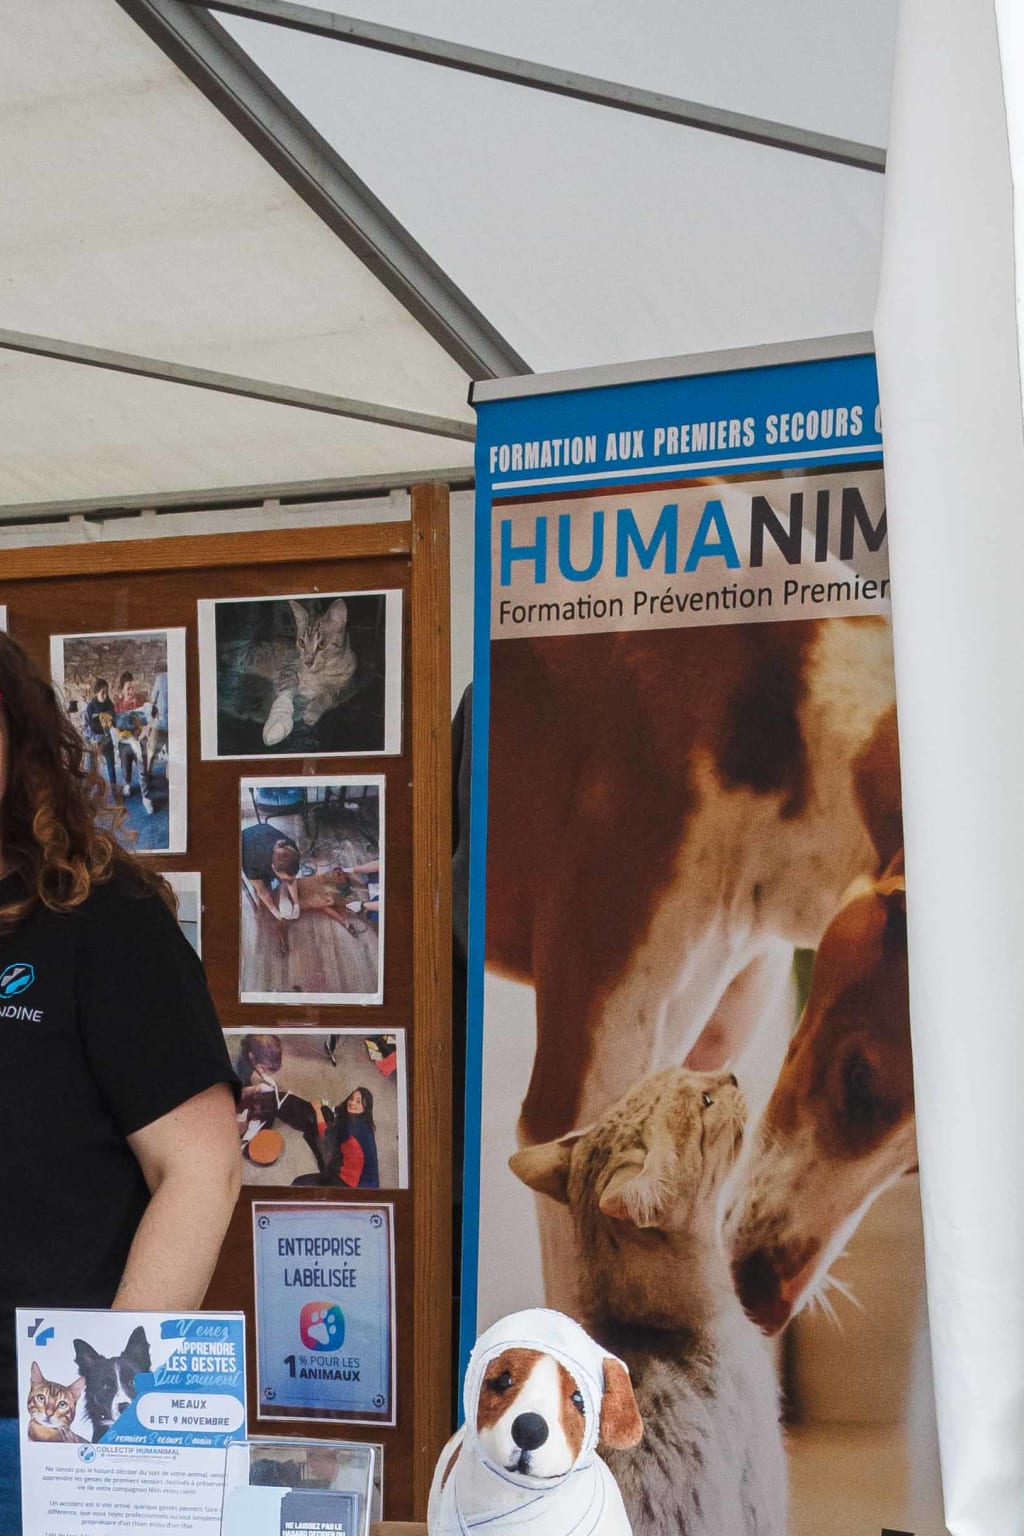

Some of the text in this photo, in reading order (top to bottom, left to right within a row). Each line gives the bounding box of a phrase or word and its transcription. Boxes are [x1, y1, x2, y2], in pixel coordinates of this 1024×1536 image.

[490, 435, 596, 474] FORMATION
[606, 430, 644, 461] AUX
[653, 418, 755, 456] PREMIERS
[766, 406, 863, 444] SECOURS
[500, 595, 624, 625] Formation
[633, 584, 773, 616] Prévention
[278, 1237, 362, 1256] ENTREPRISE
[284, 1261, 356, 1288] LABÉLISÉE
[176, 1342, 236, 1356] APPRENDRE
[166, 1356, 236, 1373] LES GESTES
[284, 1354, 296, 1378] 1
[310, 1356, 340, 1368] POUR
[342, 1358, 360, 1368] LES
[300, 1369, 360, 1382] ANIMAUX
[171, 1400, 207, 1409] MEAUX
[158, 1416, 169, 1424] ET
[173, 1416, 178, 1424] 9
[181, 1416, 230, 1425] NOVEMBRE
[96, 1446, 134, 1454] COLLECTIF
